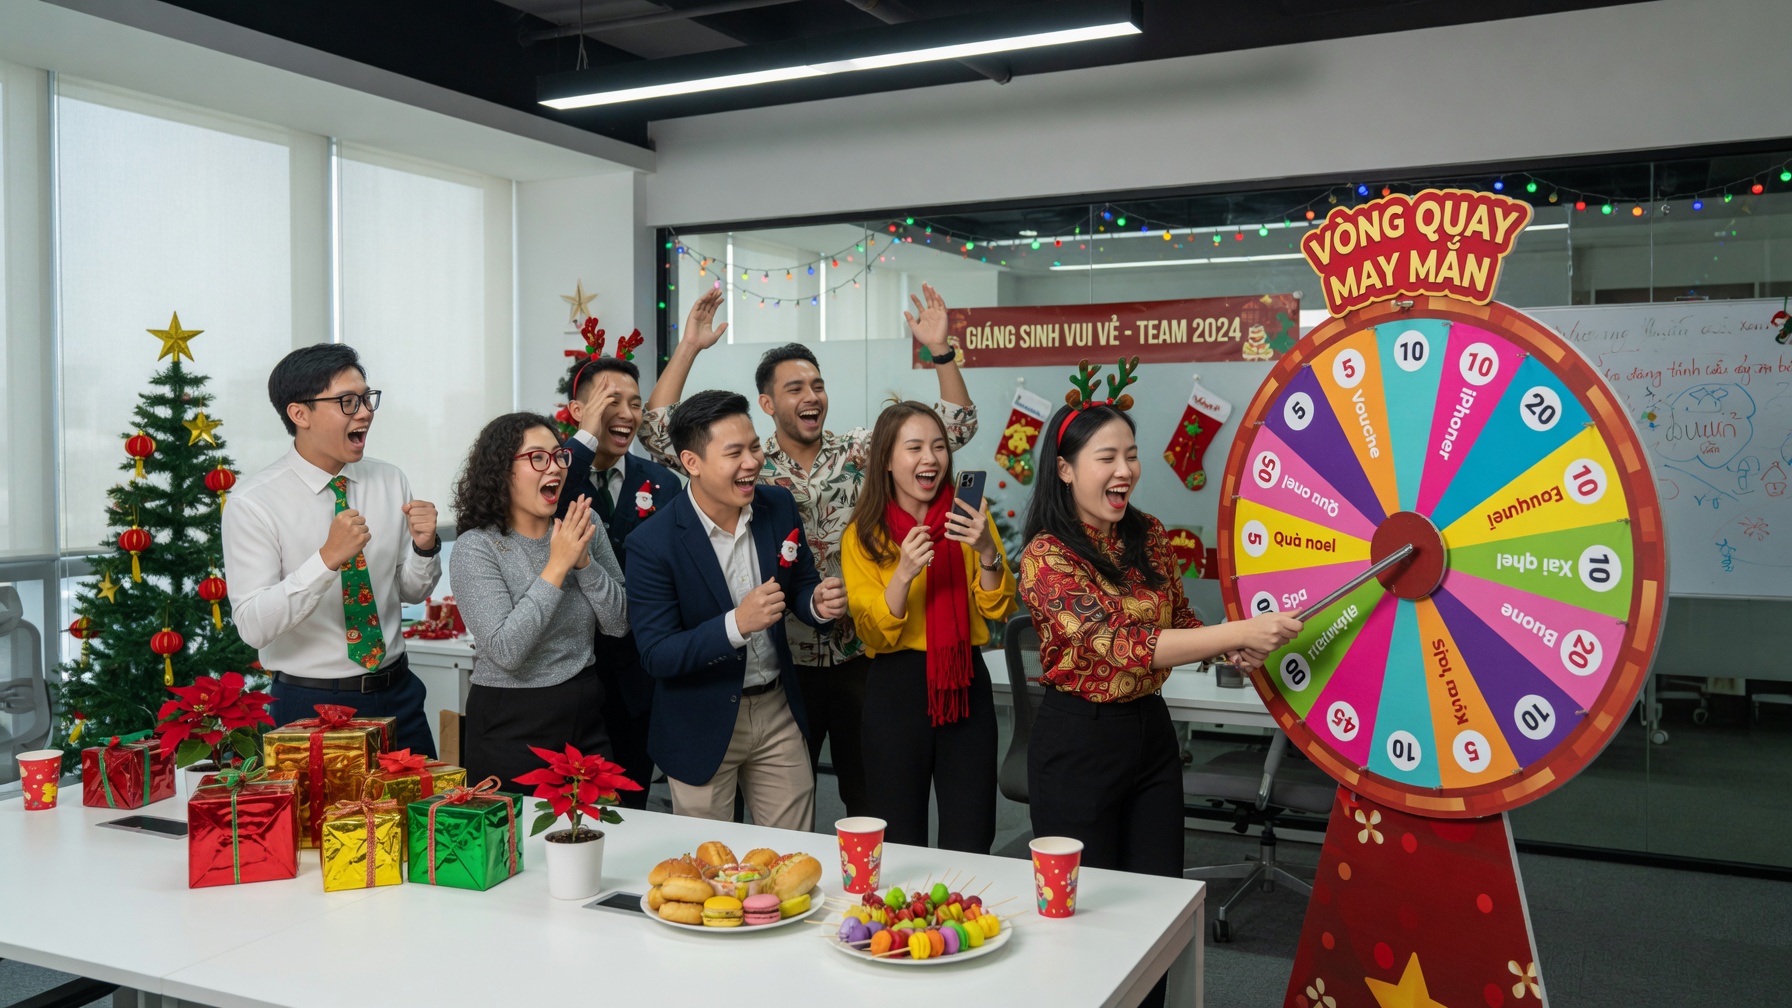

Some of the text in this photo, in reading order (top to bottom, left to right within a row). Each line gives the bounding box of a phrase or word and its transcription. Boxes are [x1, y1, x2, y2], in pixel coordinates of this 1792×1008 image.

[1308, 200, 1520, 266] VÒNG QUAY
[1329, 235, 1491, 305] MAY MẮN
[965, 320, 1016, 350] GIÁNG
[1019, 325, 1061, 348] SINH
[1064, 322, 1093, 346] VUI
[1097, 314, 1120, 346] VẺ
[1136, 318, 1188, 345] TEAM
[1191, 316, 1242, 343] 2024
[1400, 341, 1424, 362] 10
[1466, 351, 1494, 378] 10
[1341, 358, 1356, 379] 5
[1291, 401, 1306, 420] 5
[1525, 393, 1556, 425] 20
[1351, 388, 1380, 460] Vouche
[1439, 388, 1478, 461] iPhoner
[1572, 465, 1599, 496] 10
[1247, 532, 1262, 545] 5
[1273, 531, 1336, 553] Quà noel
[1542, 556, 1573, 578] Xai
[1588, 554, 1611, 584] 10
[1282, 588, 1308, 609] Spa
[1500, 602, 1559, 648] Buone
[1567, 633, 1596, 671] 20
[1332, 707, 1358, 734] 45
[1520, 701, 1550, 732] 10
[1393, 738, 1416, 763] 10
[1464, 740, 1480, 762] 5
